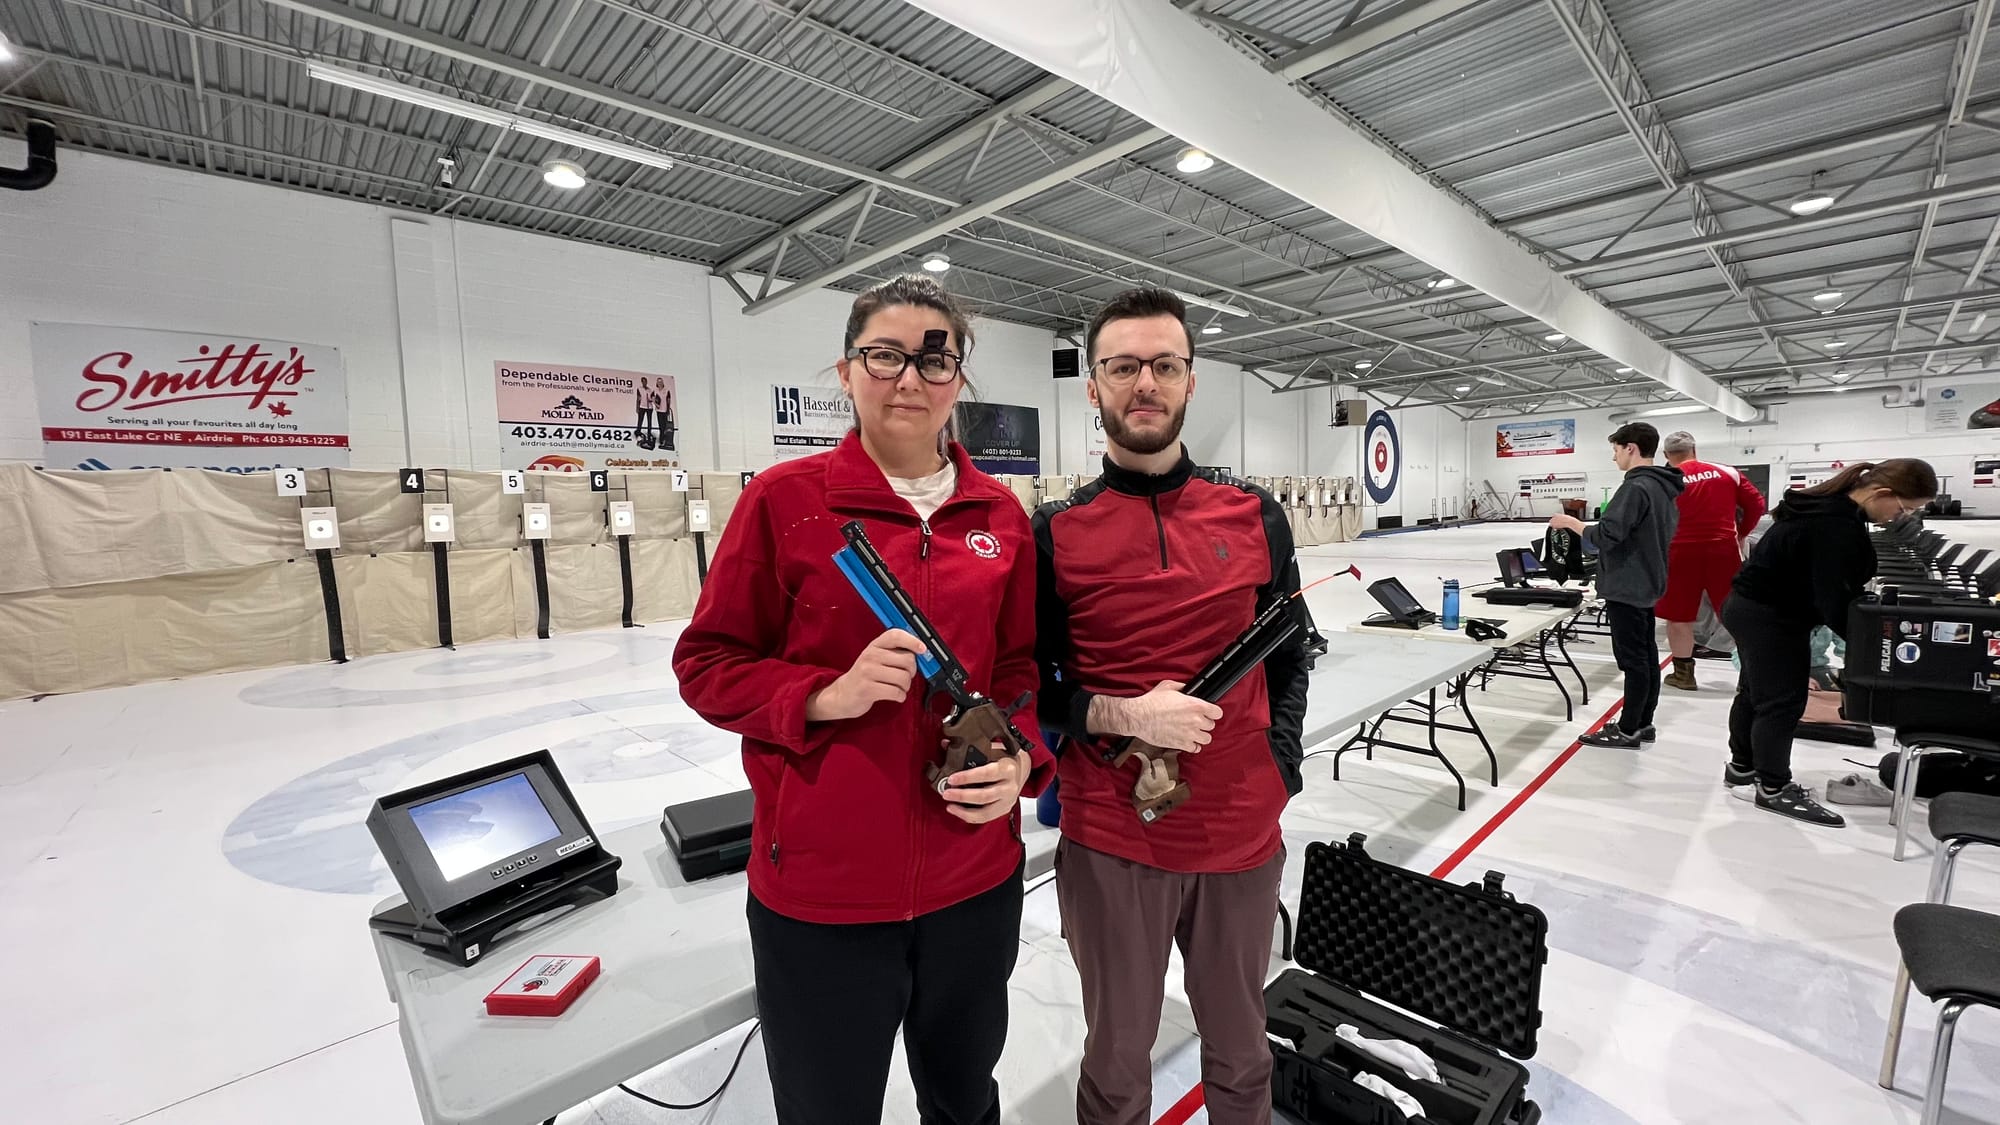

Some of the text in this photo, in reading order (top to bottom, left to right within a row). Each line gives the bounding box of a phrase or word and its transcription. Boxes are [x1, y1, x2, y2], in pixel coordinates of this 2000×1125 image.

[76, 344, 315, 412] Smitty's
[501, 368, 633, 388] Dependable Cleaning
[537, 382, 585, 391] Professionals
[843, 400, 851, 412] &
[541, 410, 604, 420] MOLLY MAID
[107, 416, 149, 426] Serving
[193, 420, 242, 428] favourites
[259, 421, 275, 430] day
[278, 422, 298, 431] long
[61, 430, 81, 440] 191
[84, 431, 113, 439] East
[115, 432, 142, 440] Lake
[164, 433, 182, 441] NE
[194, 434, 233, 442] Airdrie
[242, 435, 259, 443] Ph:
[262, 435, 336, 445] 403-945-1225
[511, 426, 633, 442] 403.470.6482
[520, 440, 625, 450] airdrie-south@mollymaid.ca
[605, 458, 648, 467] Celebrate
[285, 474, 298, 489] 3
[406, 473, 419, 488] 4
[508, 475, 518, 488] 5
[594, 475, 604, 487] 6
[675, 475, 683, 486] 7
[1683, 470, 1721, 483] ANADA
[1881, 638, 1891, 672] PELICAN
